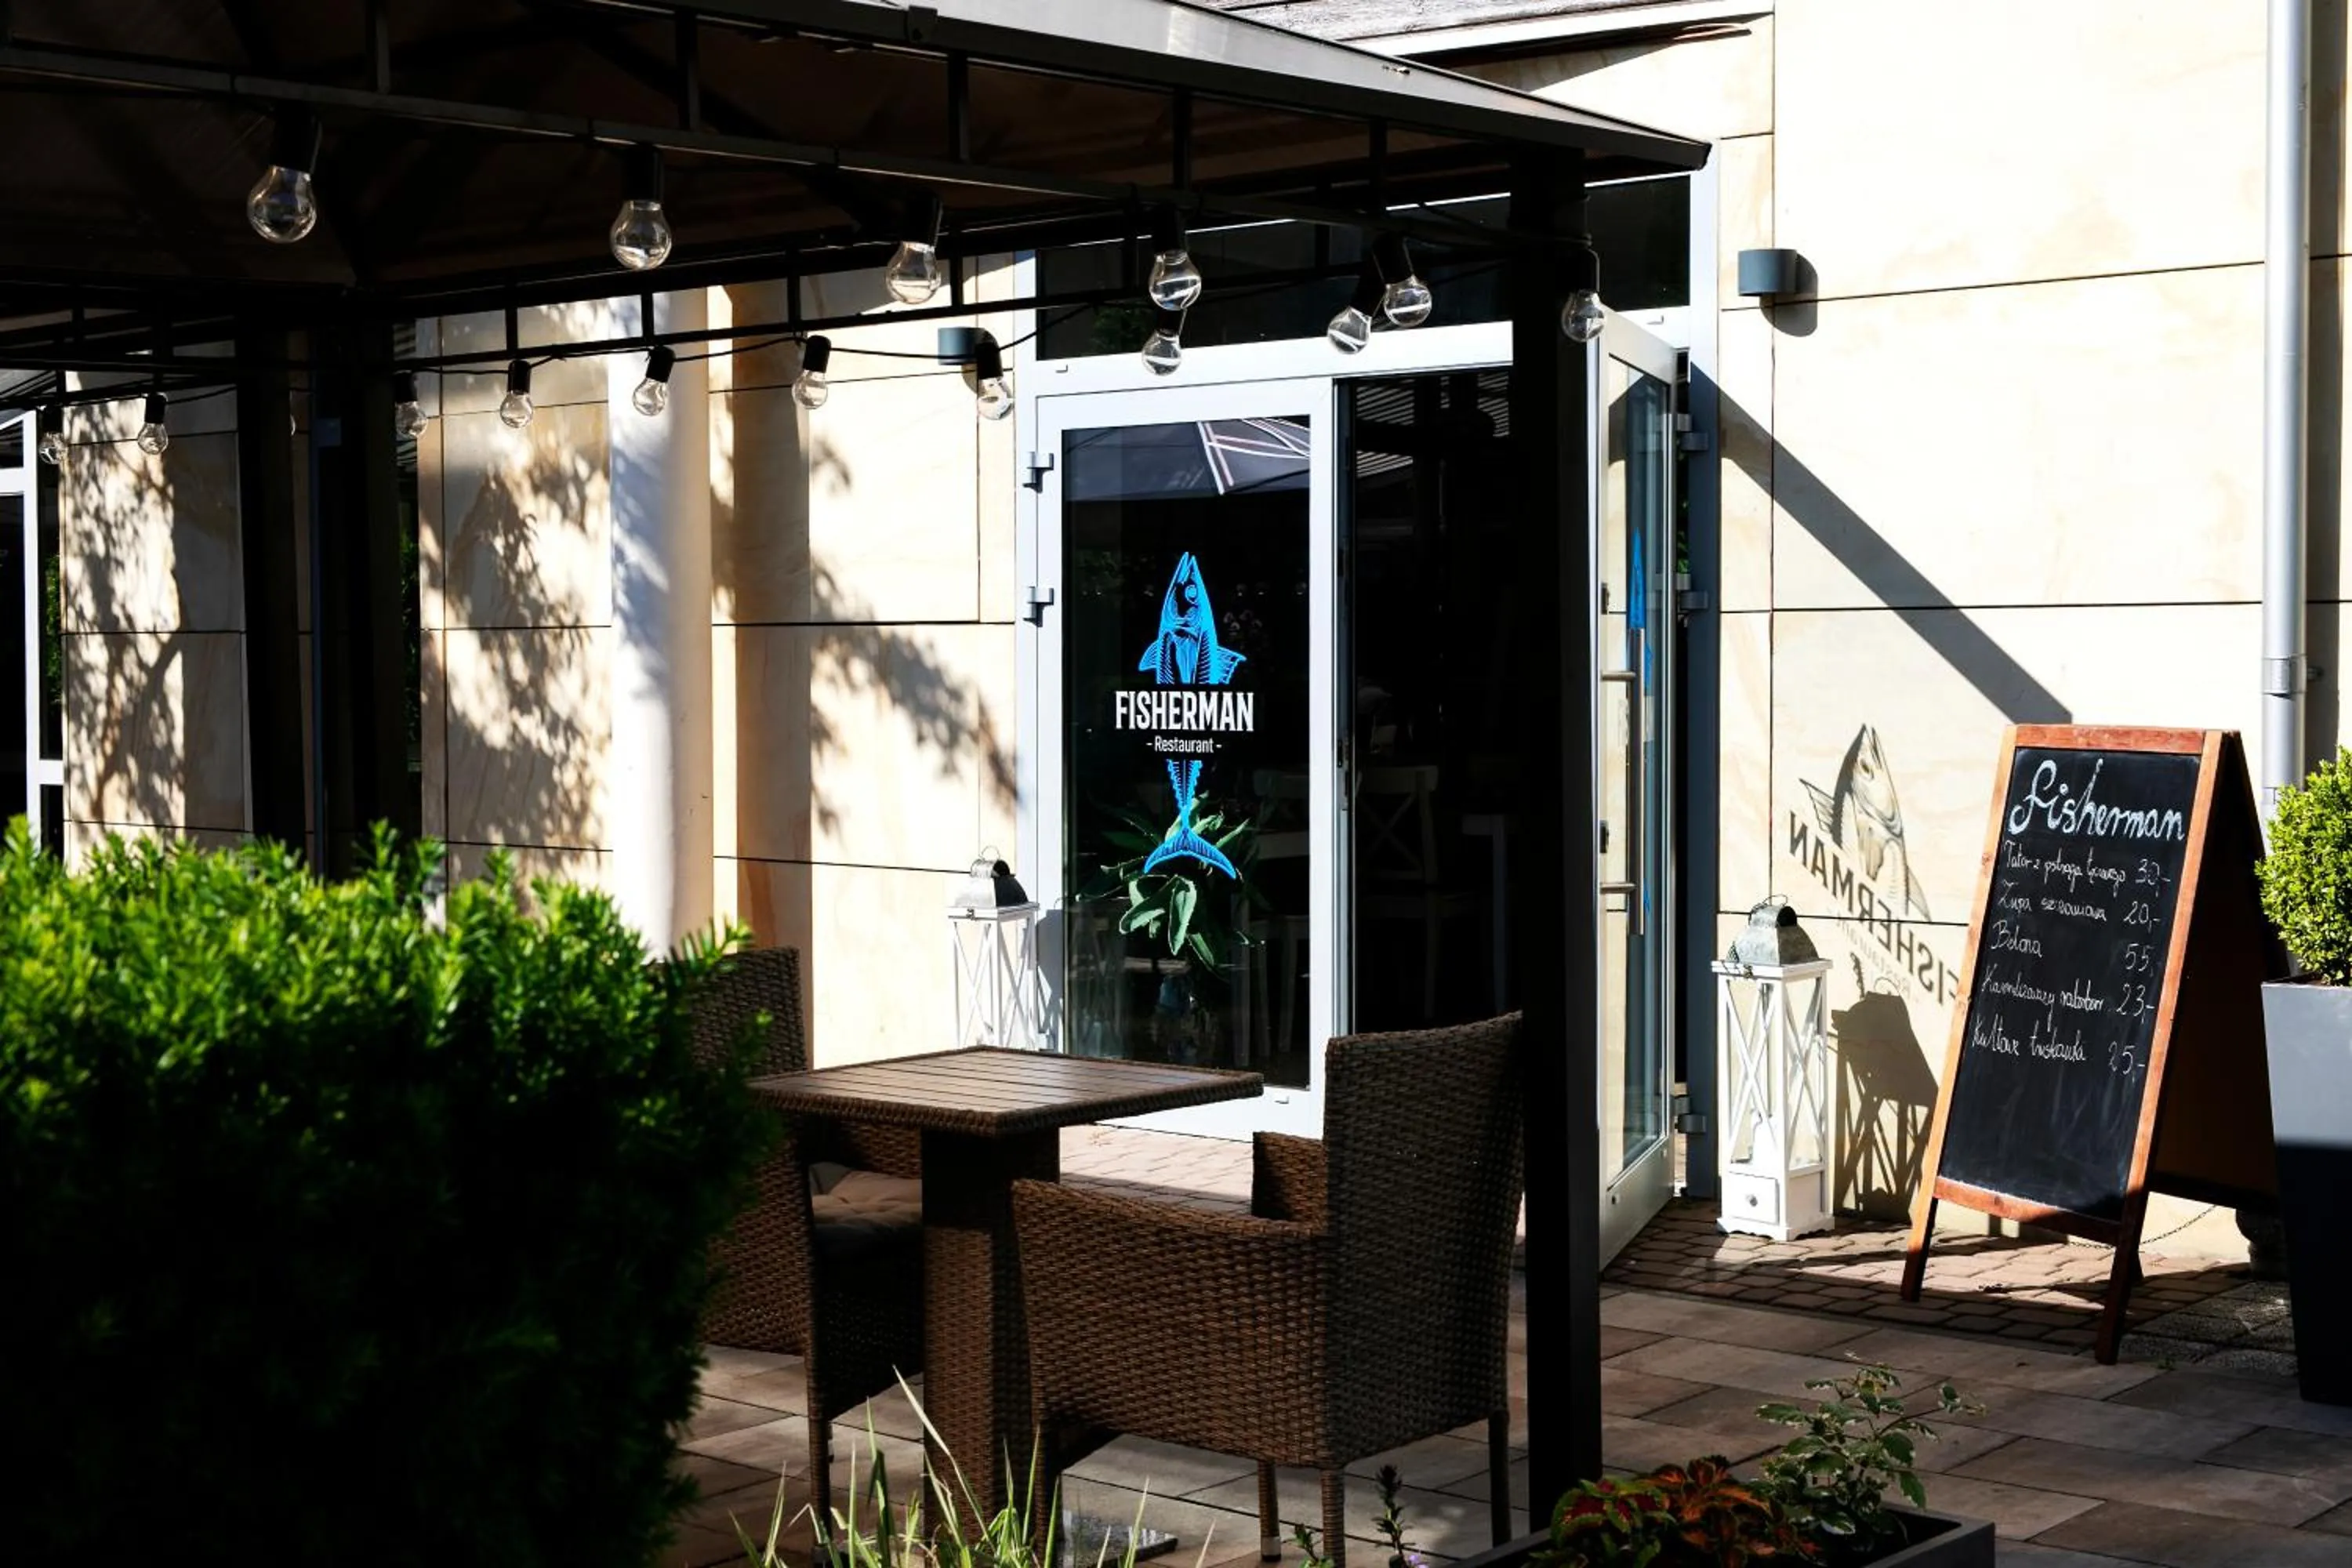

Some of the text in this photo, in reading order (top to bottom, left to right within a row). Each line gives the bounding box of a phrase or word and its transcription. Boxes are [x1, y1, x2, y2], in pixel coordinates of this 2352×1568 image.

[1115, 691, 1254, 731] FISHERMAN
[1154, 735, 1214, 753] Restaurant
[2008, 758, 2185, 840] Fisherman
[1998, 879, 2032, 916] Zupa
[1991, 919, 2042, 958] Belona
